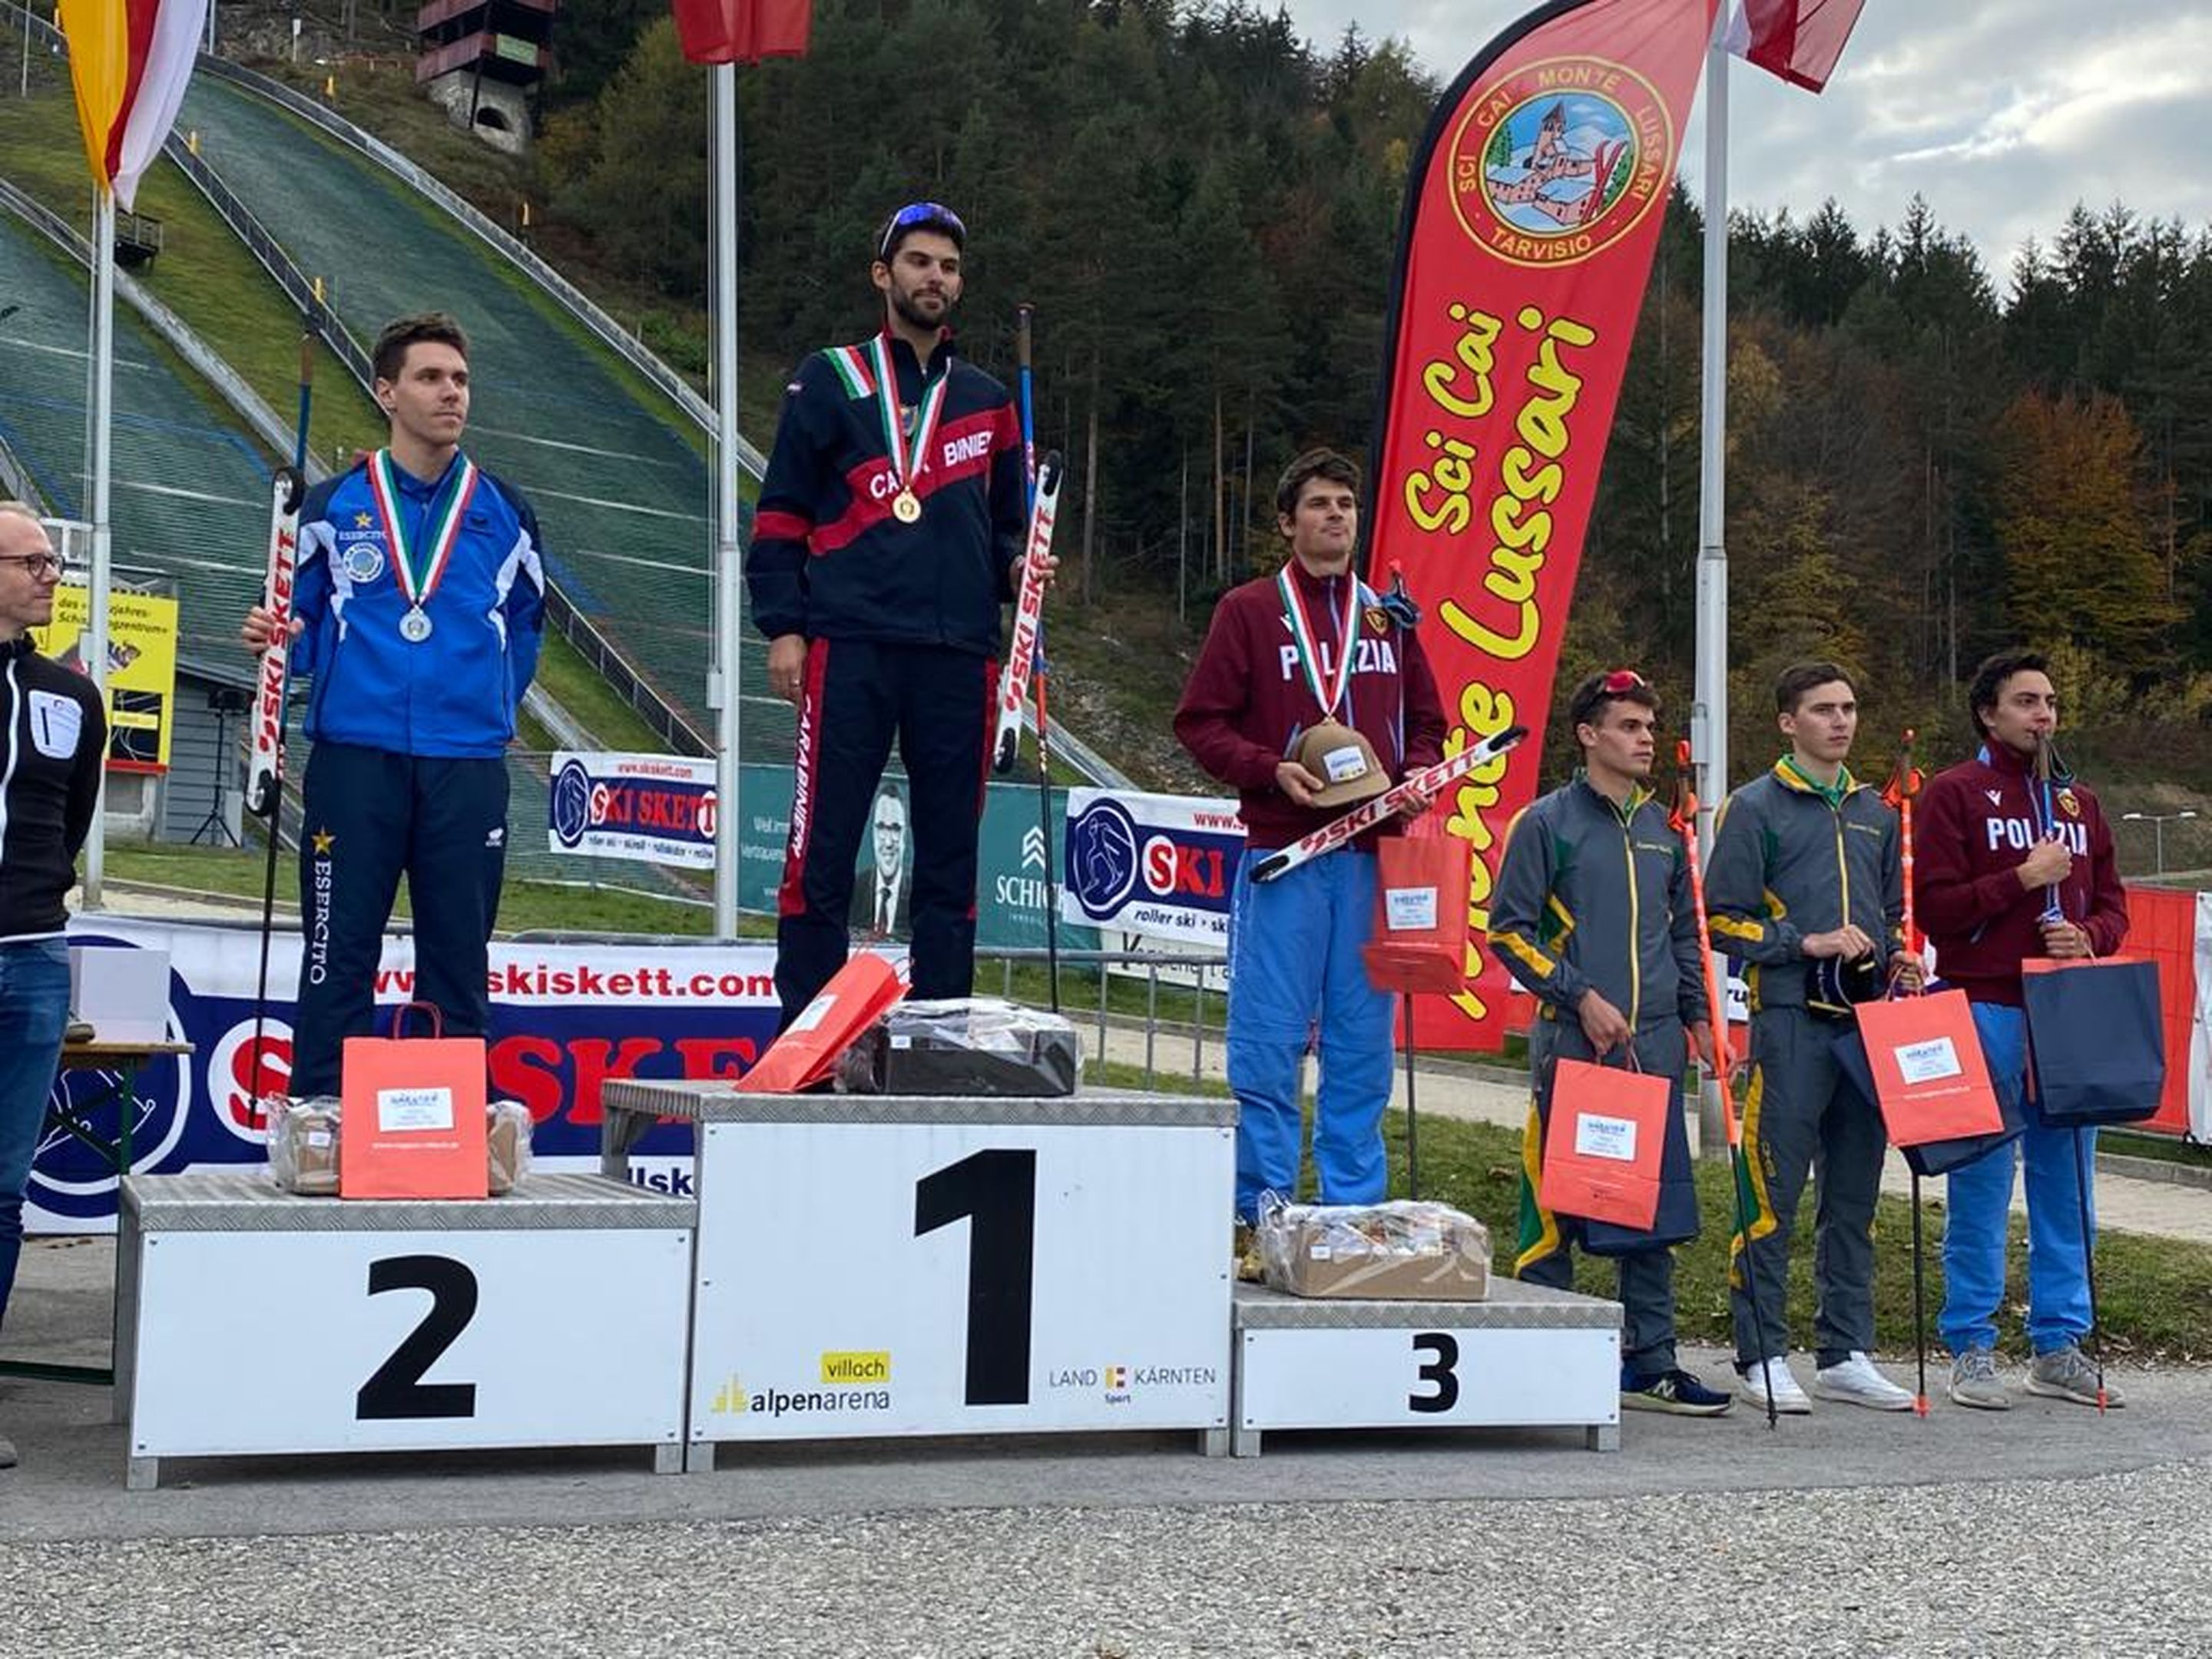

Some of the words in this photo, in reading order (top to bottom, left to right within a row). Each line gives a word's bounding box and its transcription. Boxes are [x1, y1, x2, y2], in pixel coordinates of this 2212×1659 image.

[1459, 155, 1476, 192] SCI
[1478, 90, 1513, 127] CAI
[1538, 66, 1621, 91] MONTE
[1631, 104, 1662, 201] LUSSARI
[1489, 226, 1591, 260] TARVISIO
[1421, 303, 1504, 418] Cai
[1404, 430, 1477, 535] Sci
[1438, 306, 1597, 661] Lussari
[1279, 638, 1397, 681] PLZIA
[593, 786, 632, 826] SKI
[1327, 804, 1377, 843] SKI
[1149, 843, 1225, 899] SKI
[310, 860, 332, 985] ESERCITO
[1134, 908, 1172, 926] roller
[1176, 912, 1196, 928] ski
[914, 1148, 1037, 1406] 1
[356, 1254, 479, 1420] 2
[827, 1359, 885, 1377] villach
[1049, 1369, 1098, 1387] LAND
[1134, 1366, 1216, 1385] KÄRNTEN
[1409, 1333, 1460, 1414] 3
[750, 1388, 891, 1417] alpenarena
